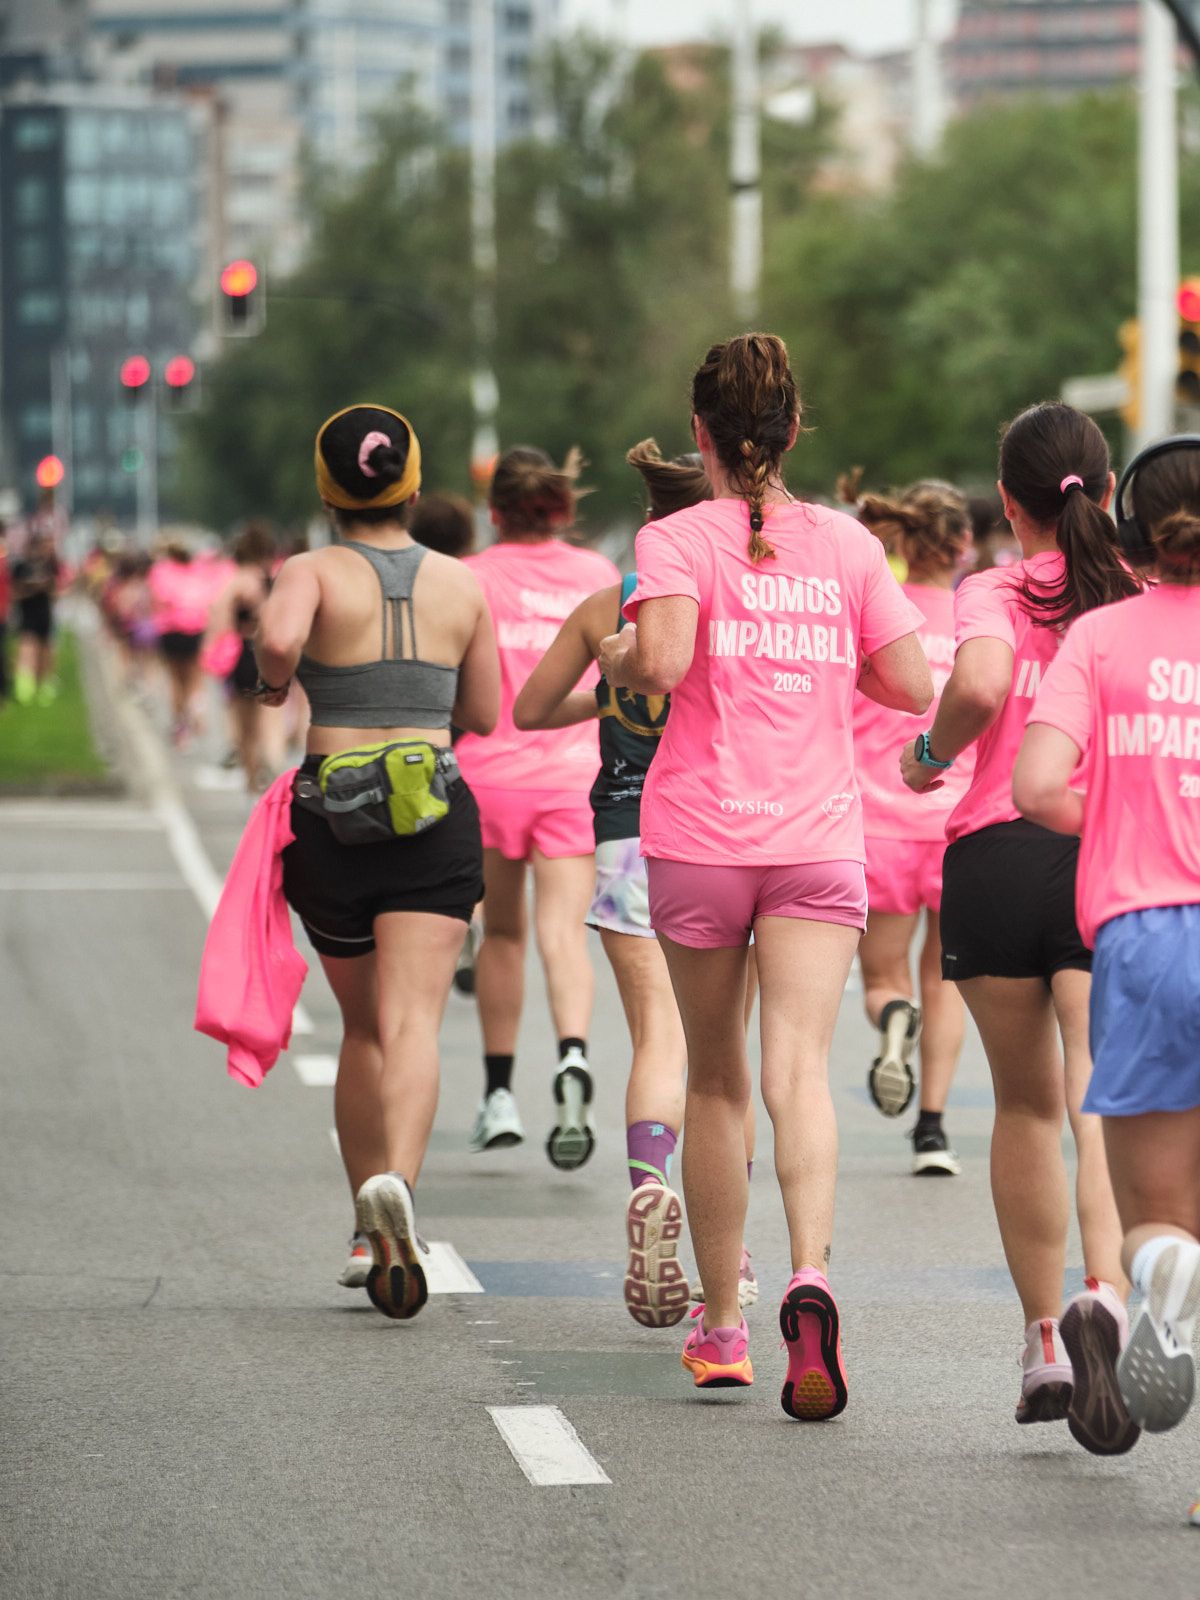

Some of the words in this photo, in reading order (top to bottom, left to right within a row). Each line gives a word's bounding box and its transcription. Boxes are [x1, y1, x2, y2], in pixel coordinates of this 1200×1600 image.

[741, 573, 842, 616] SOMOS
[708, 619, 857, 669] IMPARABL
[773, 672, 812, 693] 2026
[720, 799, 784, 817] OYSHO
